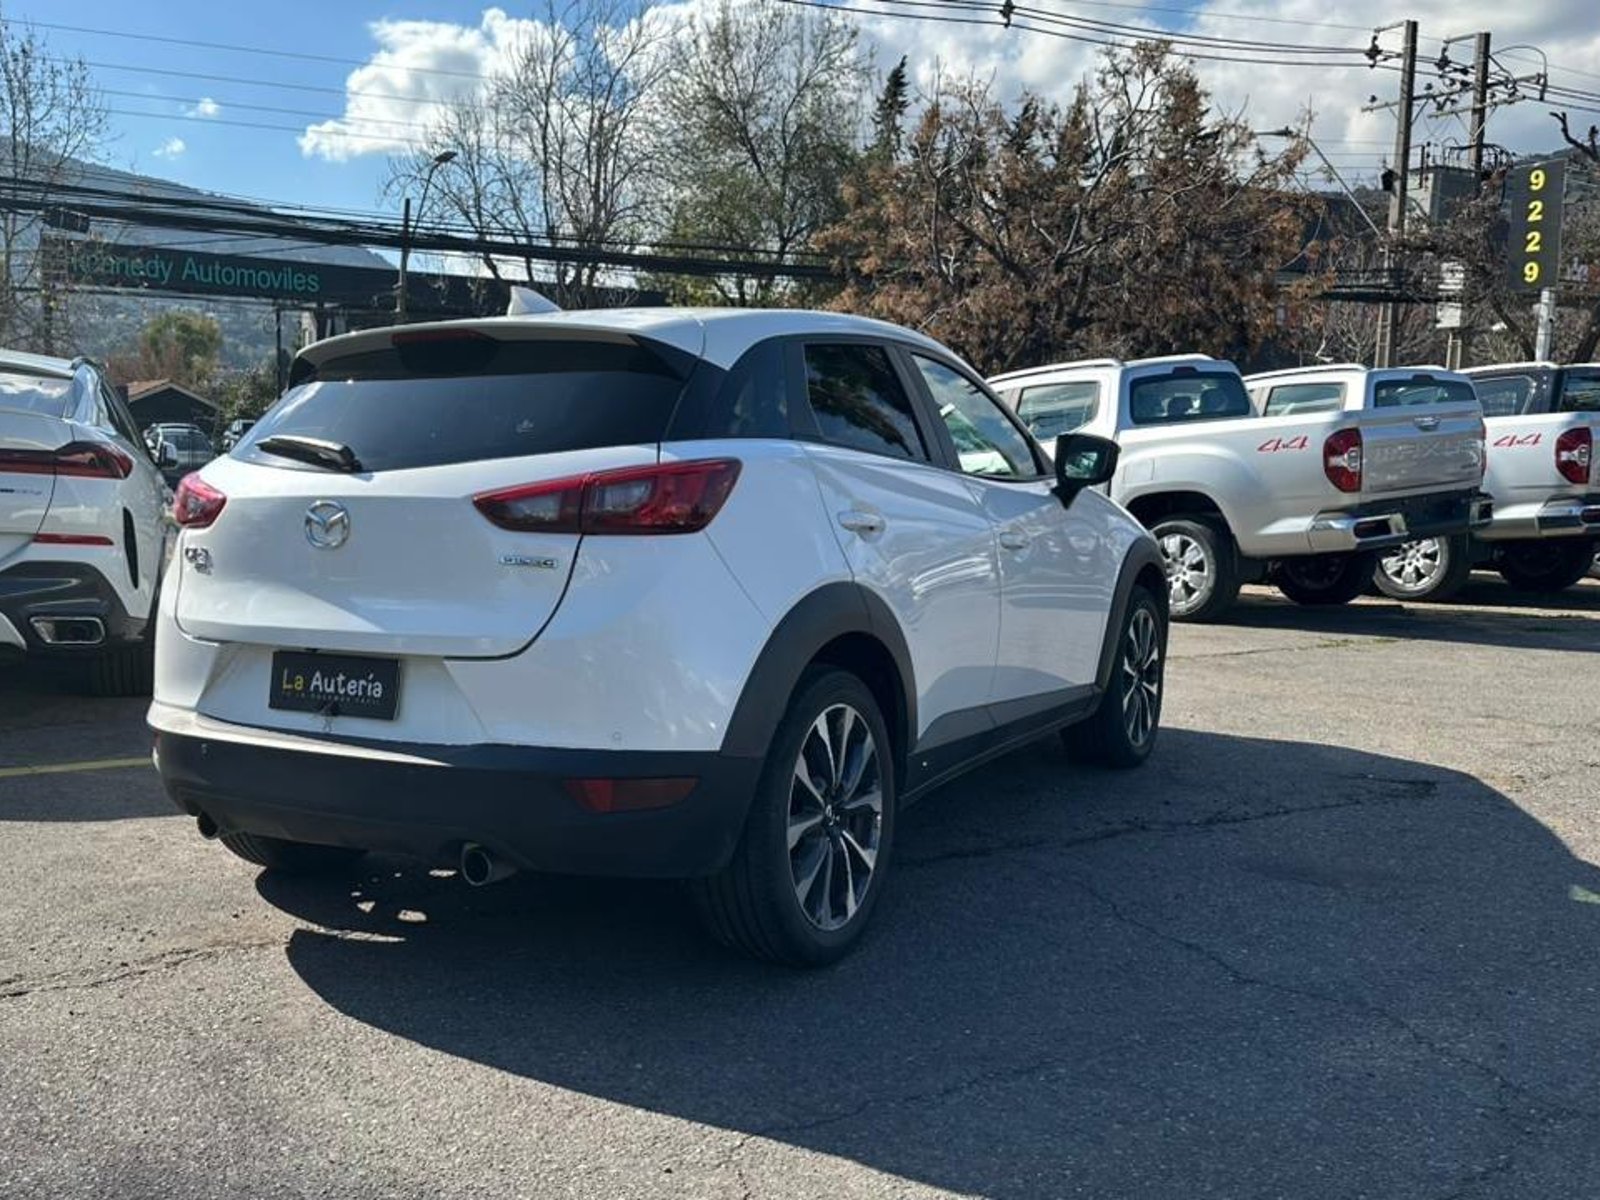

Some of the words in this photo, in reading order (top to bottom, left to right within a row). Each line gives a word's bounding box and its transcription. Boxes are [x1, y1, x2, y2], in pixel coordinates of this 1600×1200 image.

[182, 257, 321, 294] Automoviles
[282, 668, 305, 690] La
[309, 670, 384, 698] Autería
